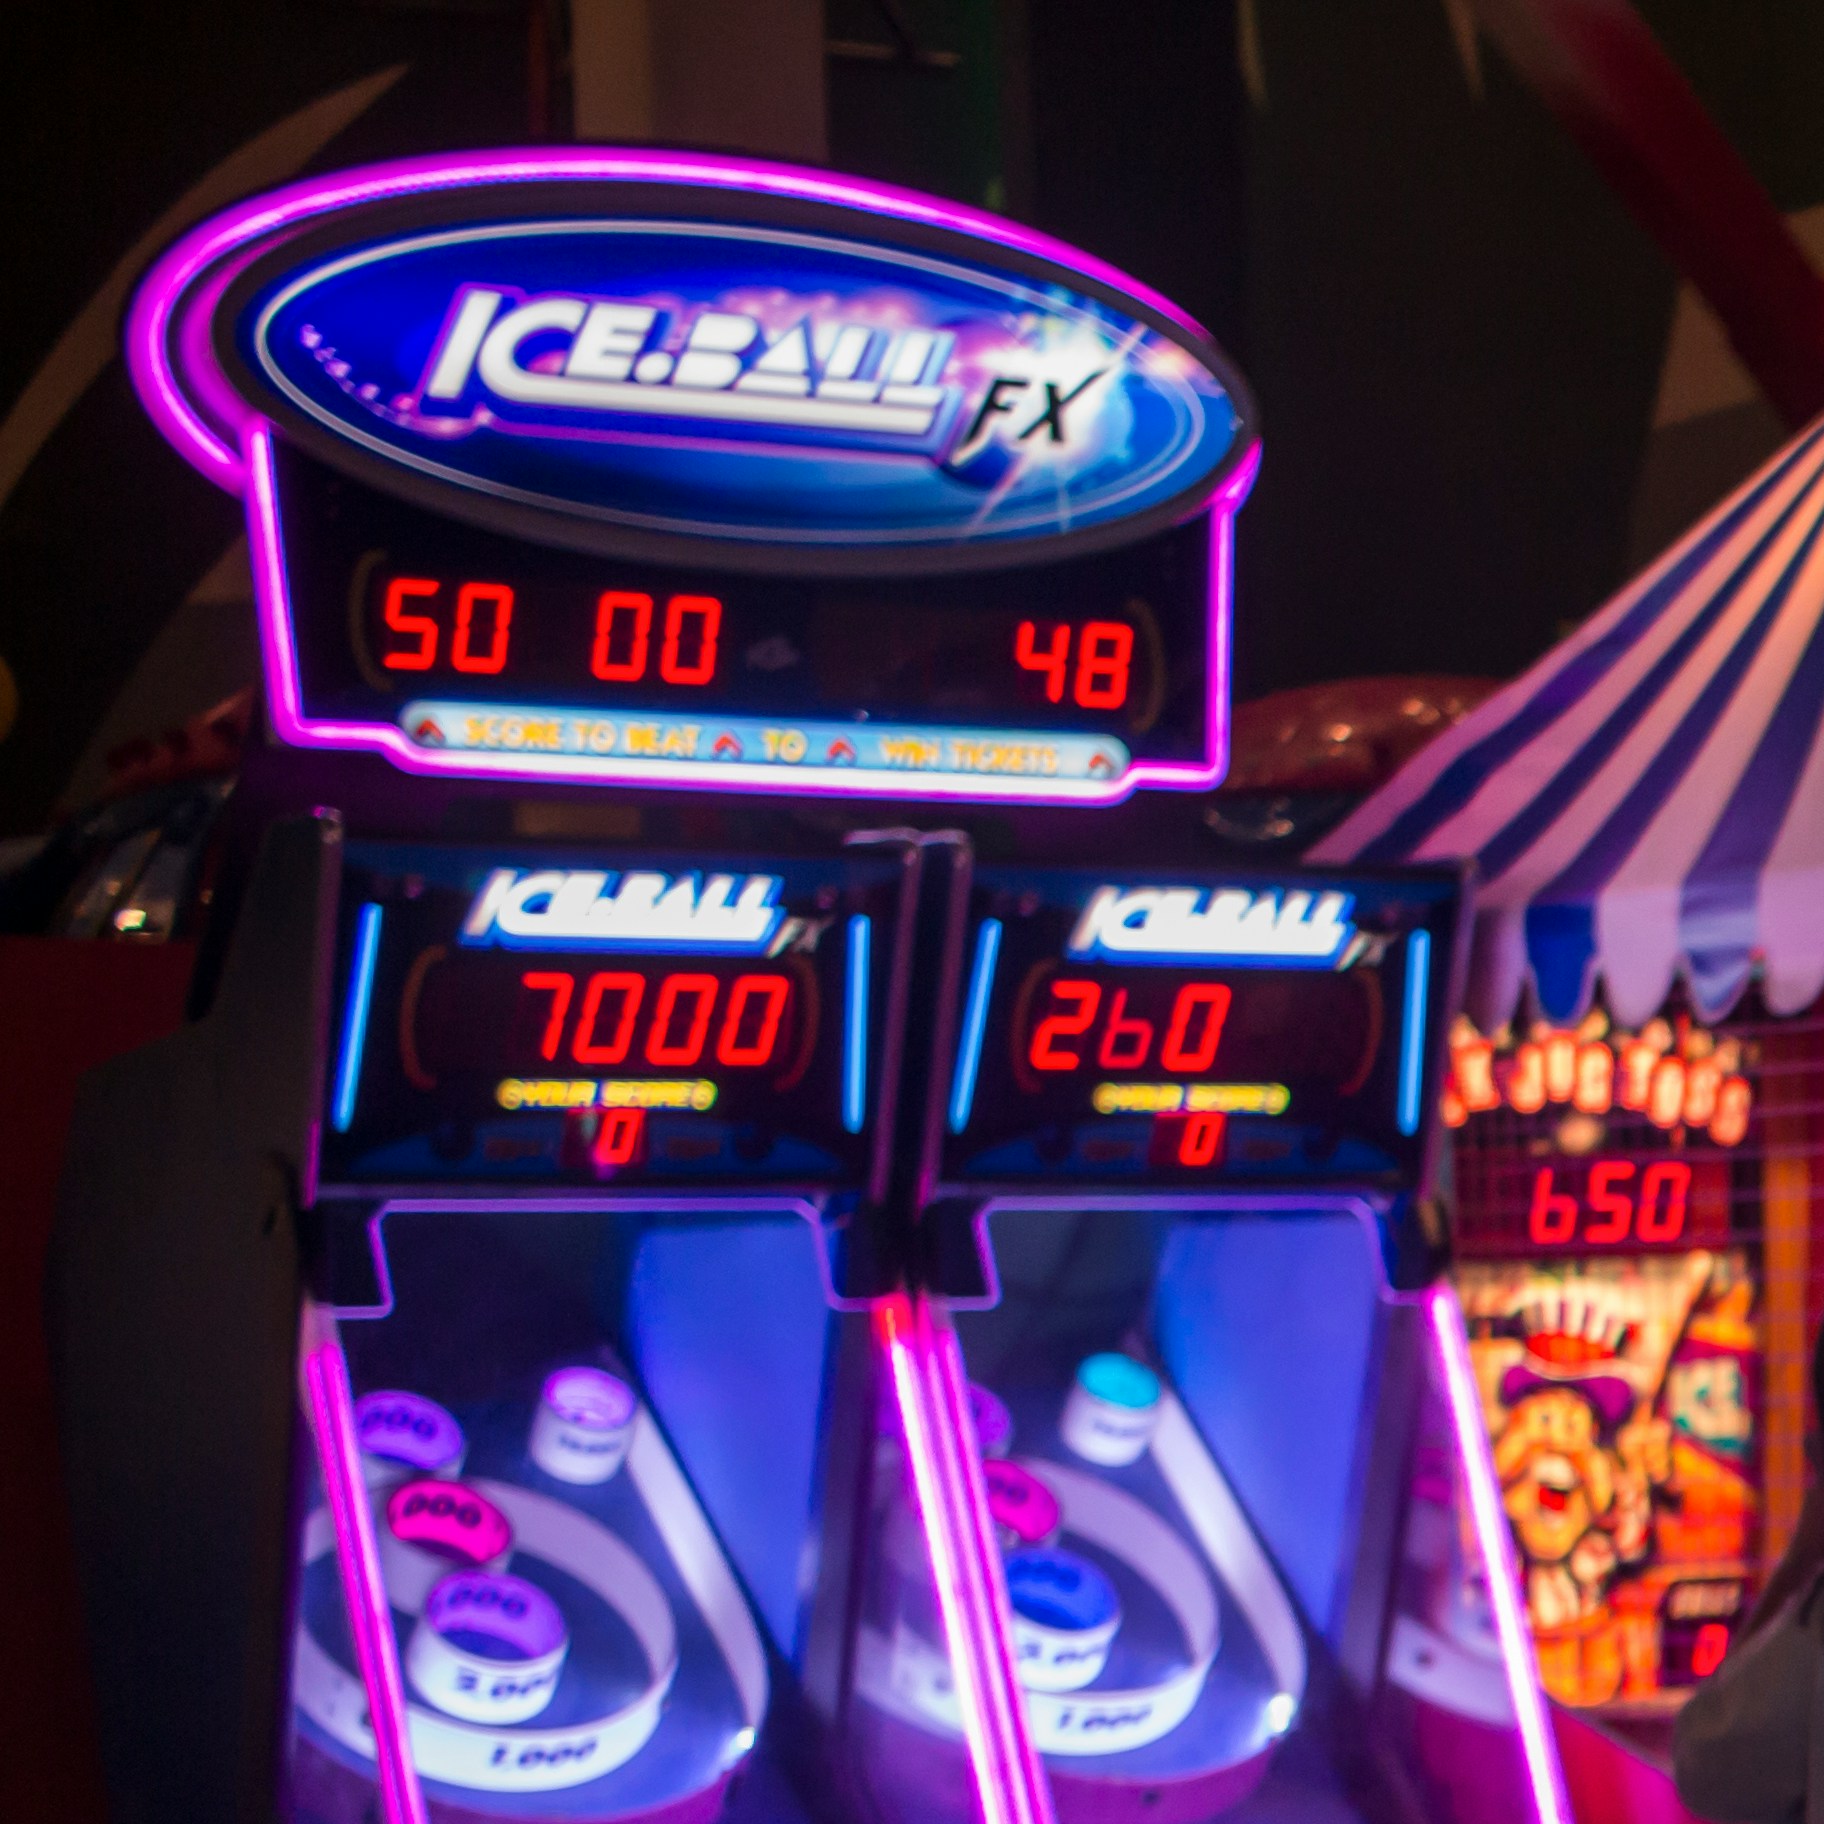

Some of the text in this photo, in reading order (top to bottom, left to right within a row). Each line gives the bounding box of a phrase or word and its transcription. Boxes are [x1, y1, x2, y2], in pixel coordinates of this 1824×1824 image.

[950, 372, 1108, 468] FX
[384, 579, 1134, 710] 50 00 48
[464, 715, 562, 752] SCORE
[573, 719, 611, 752] TO
[763, 728, 806, 761] TO
[522, 971, 790, 1066] 7000
[1029, 979, 1232, 1071] 260
[596, 1110, 643, 1165] 0
[1178, 1112, 1227, 1166] 0
[1529, 1160, 1692, 1245] 650
